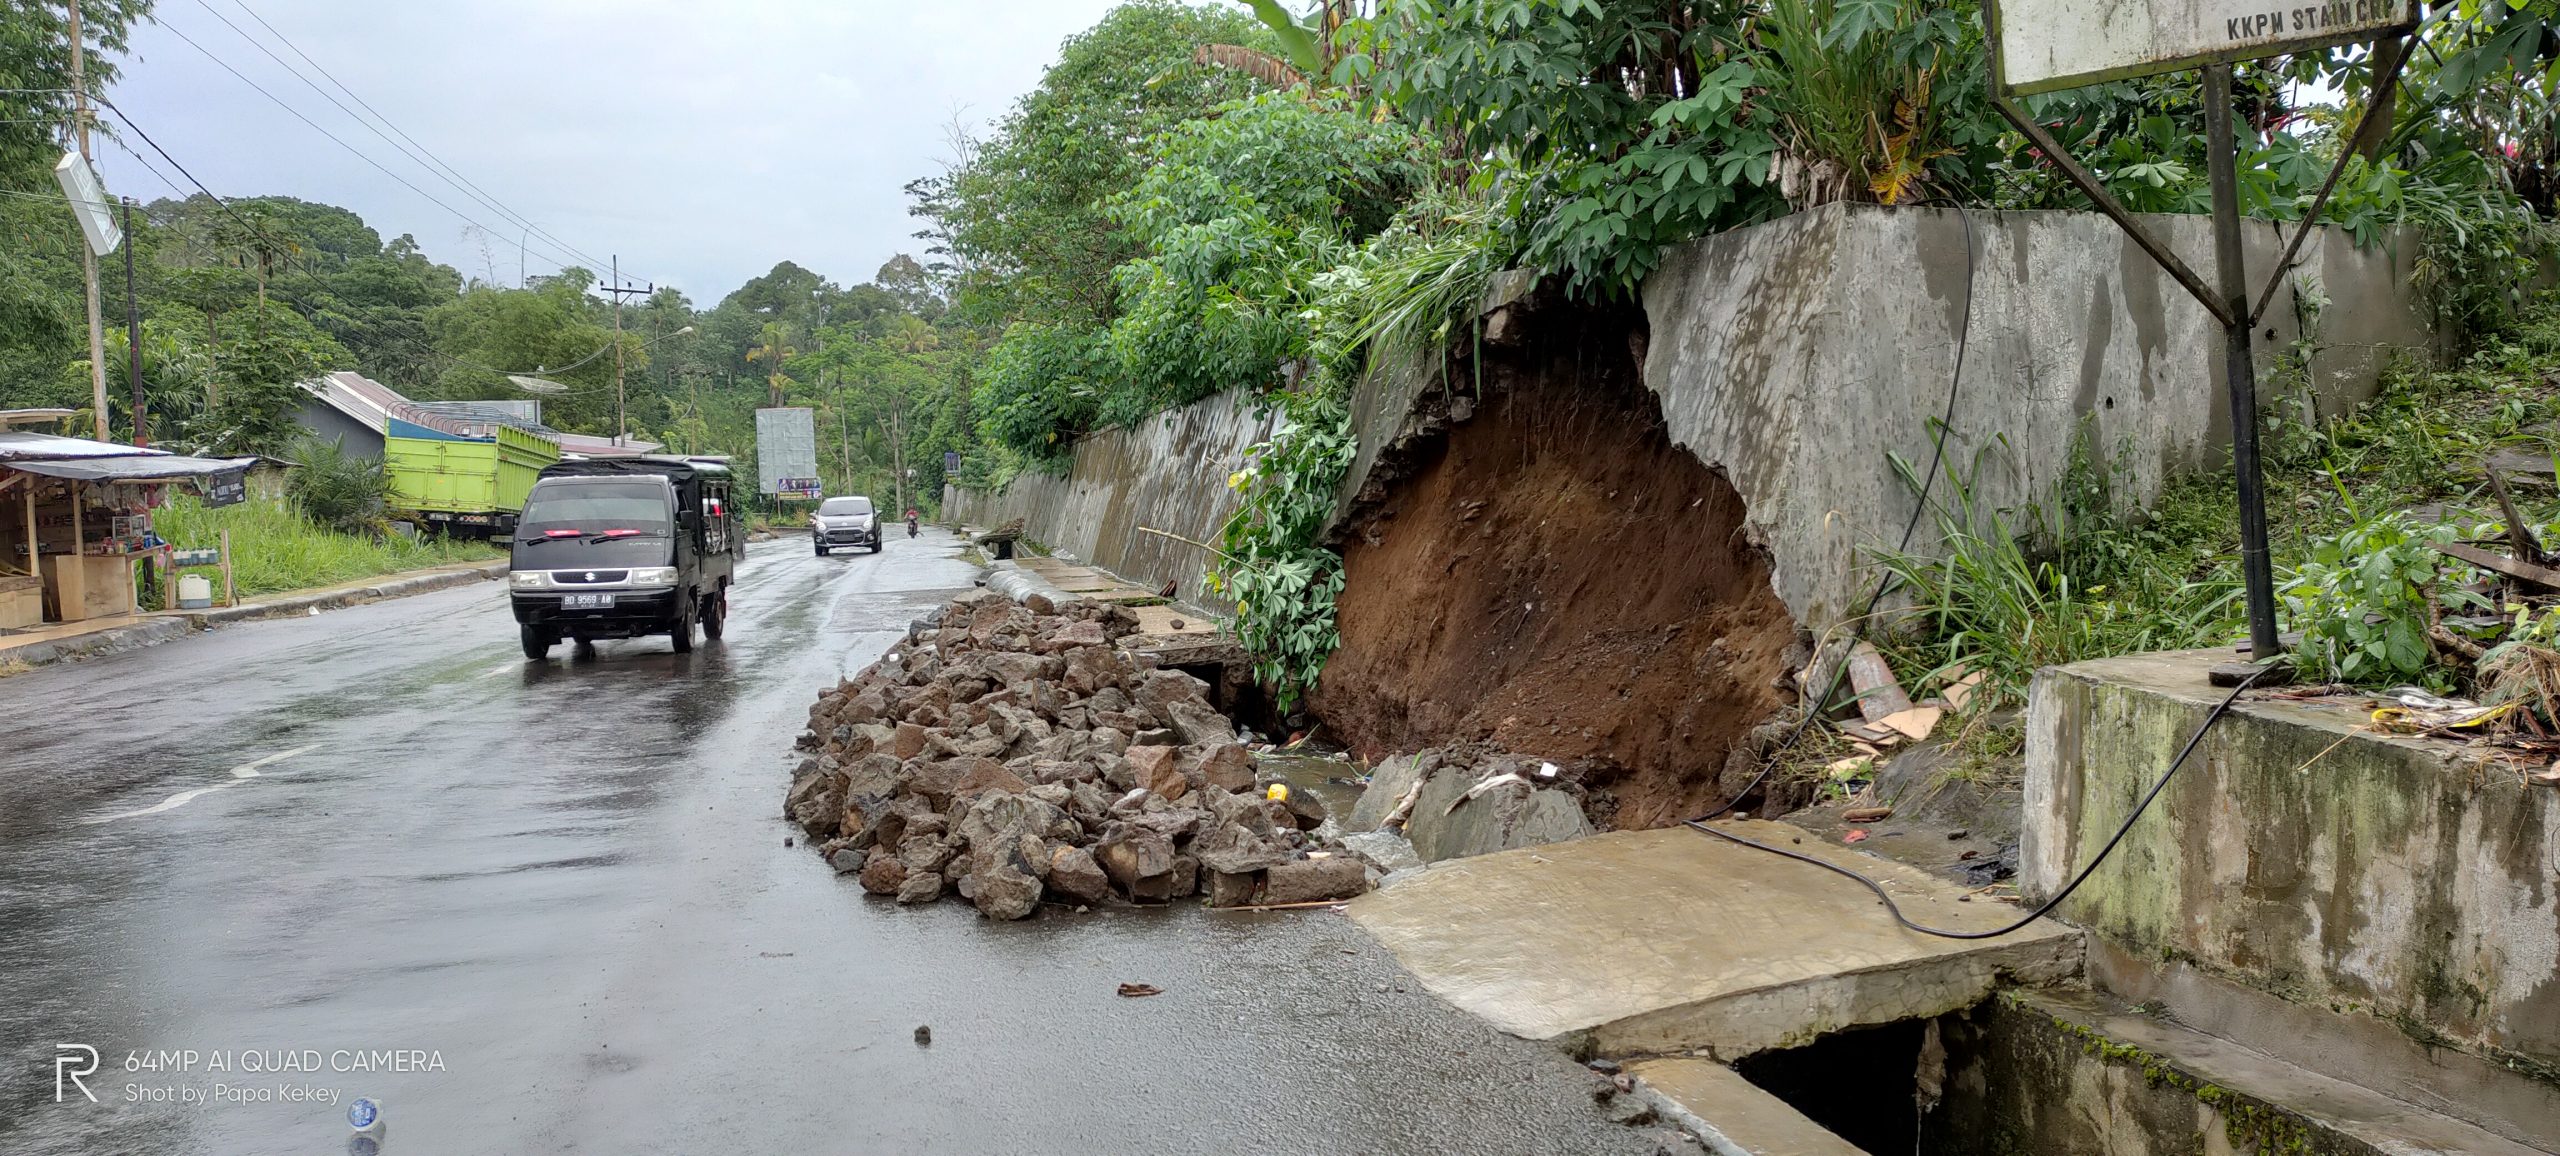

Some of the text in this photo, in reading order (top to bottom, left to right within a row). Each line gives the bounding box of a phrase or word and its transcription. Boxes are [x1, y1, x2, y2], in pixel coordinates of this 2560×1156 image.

[2227, 11, 2284, 41] KKPM
[2292, 2, 2351, 31] STAIN
[564, 596, 575, 605] BD
[577, 595, 597, 604] 9569
